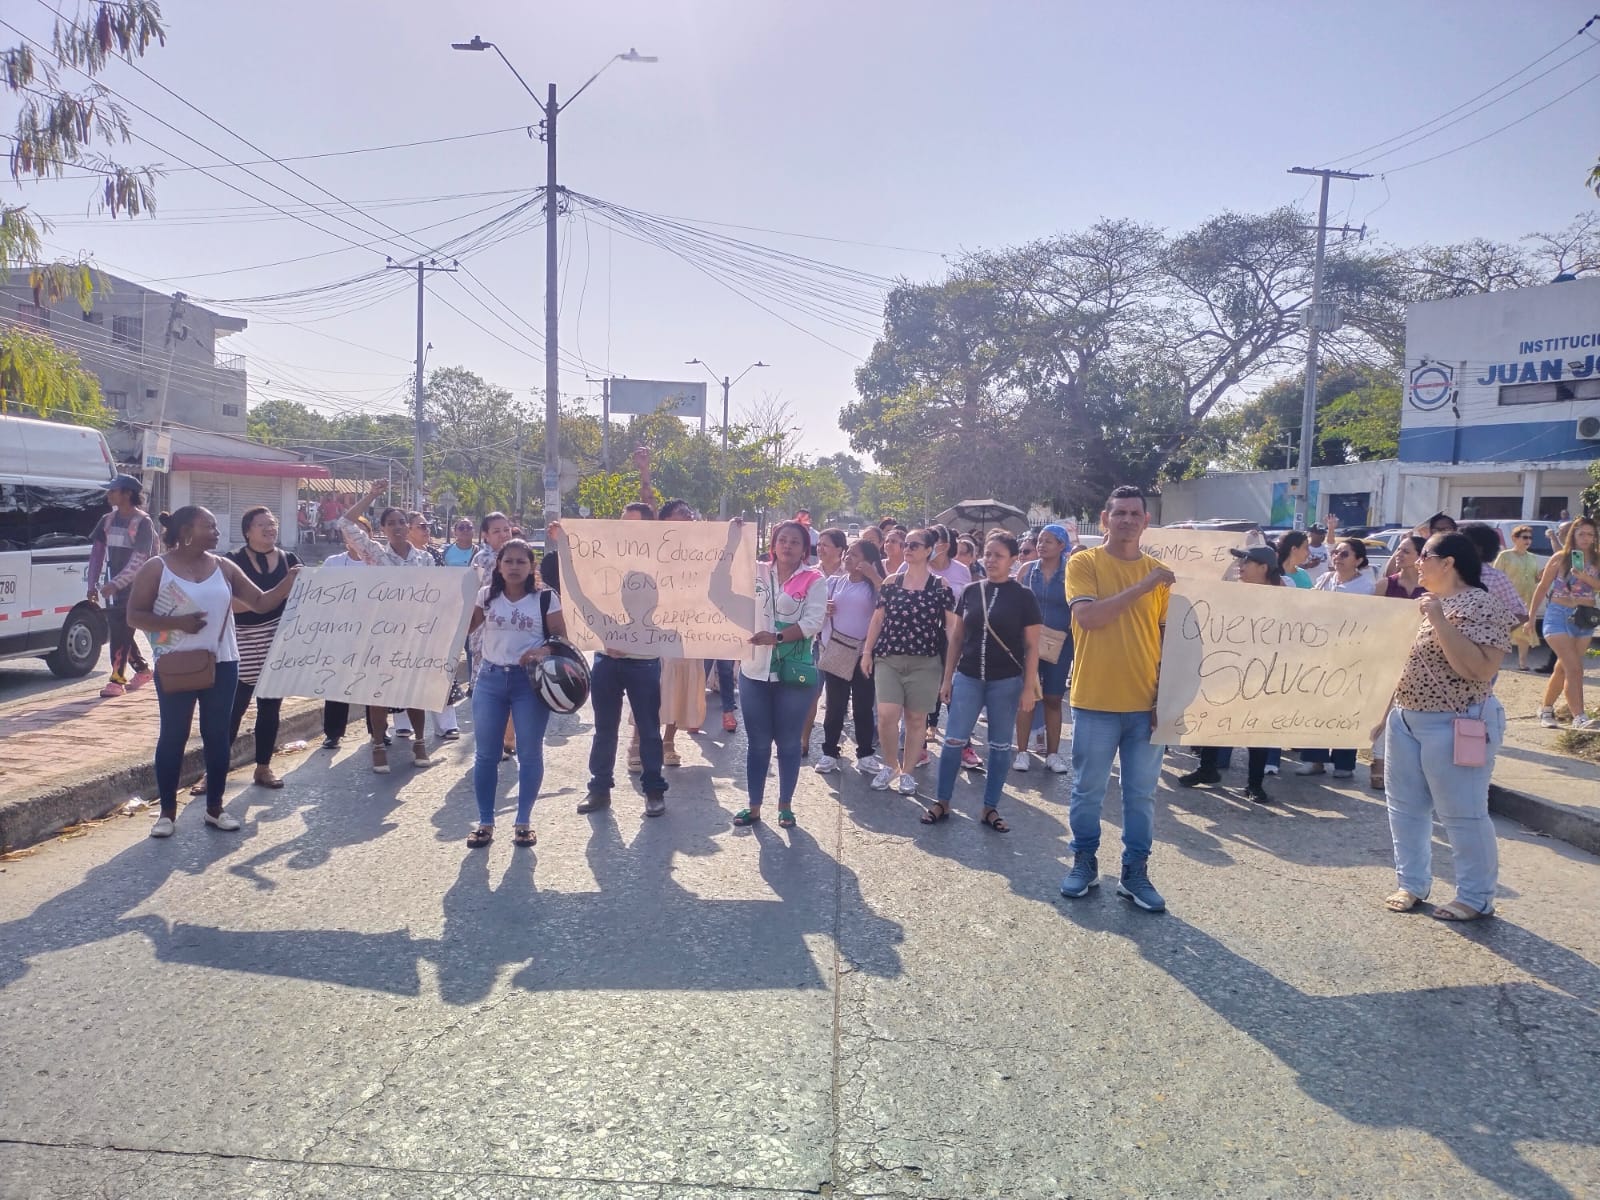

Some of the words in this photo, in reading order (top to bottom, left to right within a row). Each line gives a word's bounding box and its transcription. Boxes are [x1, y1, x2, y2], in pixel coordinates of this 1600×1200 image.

[1519, 333, 1600, 355] INSTITUCI
[1477, 358, 1563, 386] JUAN
[1572, 354, 1600, 378] J
[567, 532, 605, 559] POR
[371, 618, 406, 635] con
[414, 616, 438, 635] el
[270, 648, 336, 671] derecho
[342, 652, 355, 667] a
[364, 647, 381, 669] la
[1217, 716, 1232, 731] a
[1241, 710, 1259, 731] la
